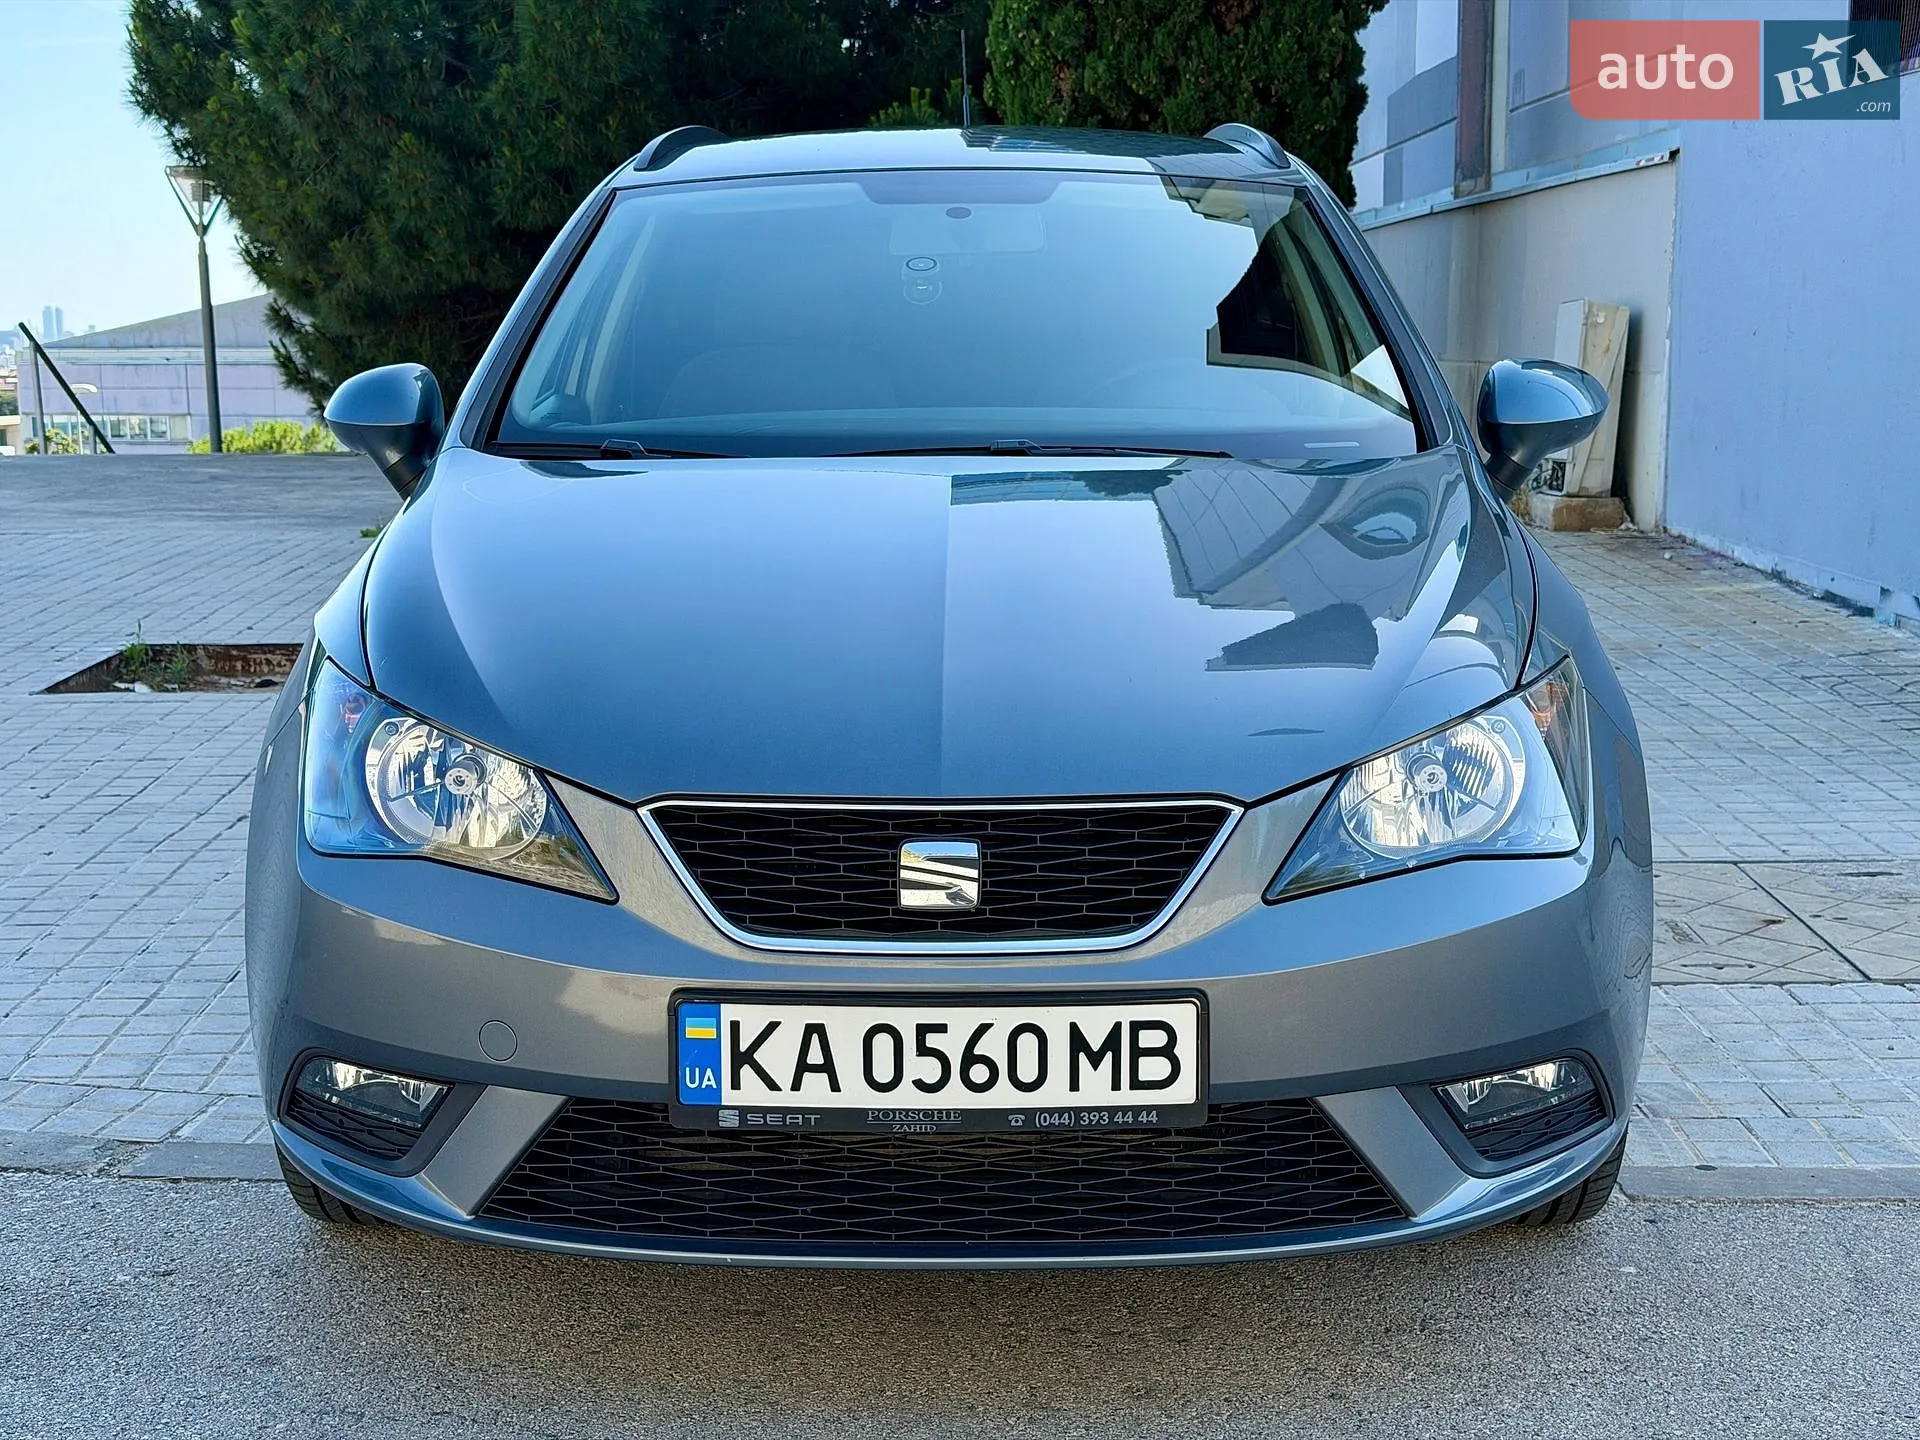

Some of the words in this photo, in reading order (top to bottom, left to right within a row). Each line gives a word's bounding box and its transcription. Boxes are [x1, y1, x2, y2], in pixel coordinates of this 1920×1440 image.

[729, 1020, 842, 1093] KA
[862, 1021, 1049, 1094] 0560
[1069, 1019, 1182, 1093] MB
[685, 1067, 717, 1089] UA
[746, 1113, 821, 1126] SEAT
[866, 1110, 962, 1121] PORSCHE
[1035, 1111, 1075, 1128] (044)
[1079, 1111, 1109, 1125] 393
[1113, 1111, 1134, 1124] 44
[1138, 1110, 1158, 1124] 44
[892, 1124, 937, 1132] ZAHID
